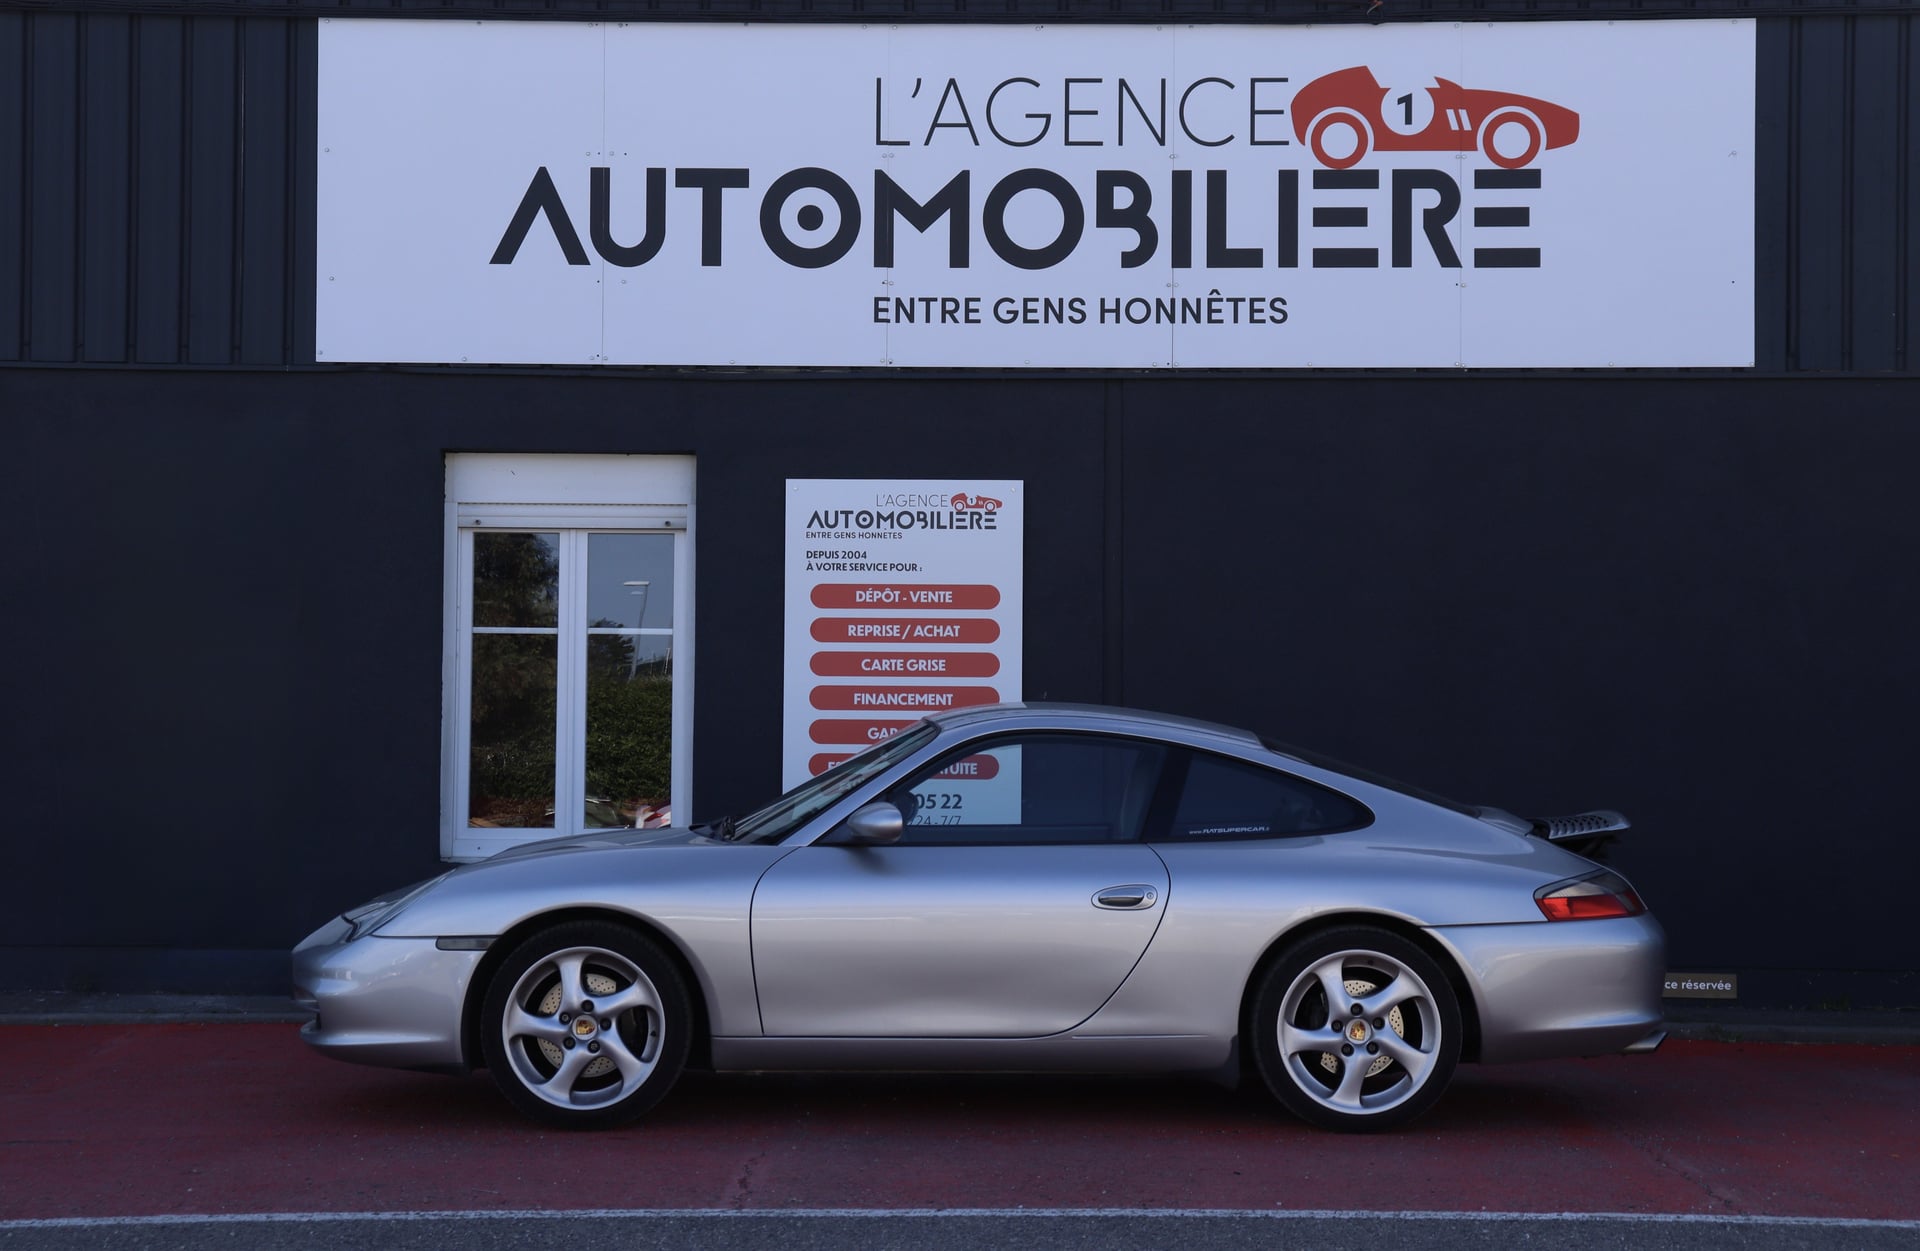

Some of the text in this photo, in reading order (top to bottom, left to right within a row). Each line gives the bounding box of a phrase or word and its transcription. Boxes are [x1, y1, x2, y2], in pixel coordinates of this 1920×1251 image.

[875, 77, 1290, 147] L'AGENCE
[1397, 93, 1413, 125] 1
[873, 289, 1289, 325] ENTRE GENS HONNÊTES
[876, 494, 948, 507] L'AGENCE
[806, 531, 832, 539] ENTRE
[834, 531, 857, 539] GENS
[806, 550, 867, 560] DEPUIS 2004
[806, 560, 814, 571] À
[816, 562, 848, 572] VOTRE
[849, 562, 888, 572] SERVICE
[889, 562, 918, 572] POUR
[855, 587, 901, 603] DÉPÔT
[909, 591, 953, 603] VENTE
[847, 624, 901, 637] REPRISE
[913, 625, 961, 638] ACHAT
[861, 659, 946, 671] CARTE GRISE
[853, 693, 954, 706] FINANCEMENT
[940, 794, 963, 809] 22
[1681, 979, 1732, 991] réservée
